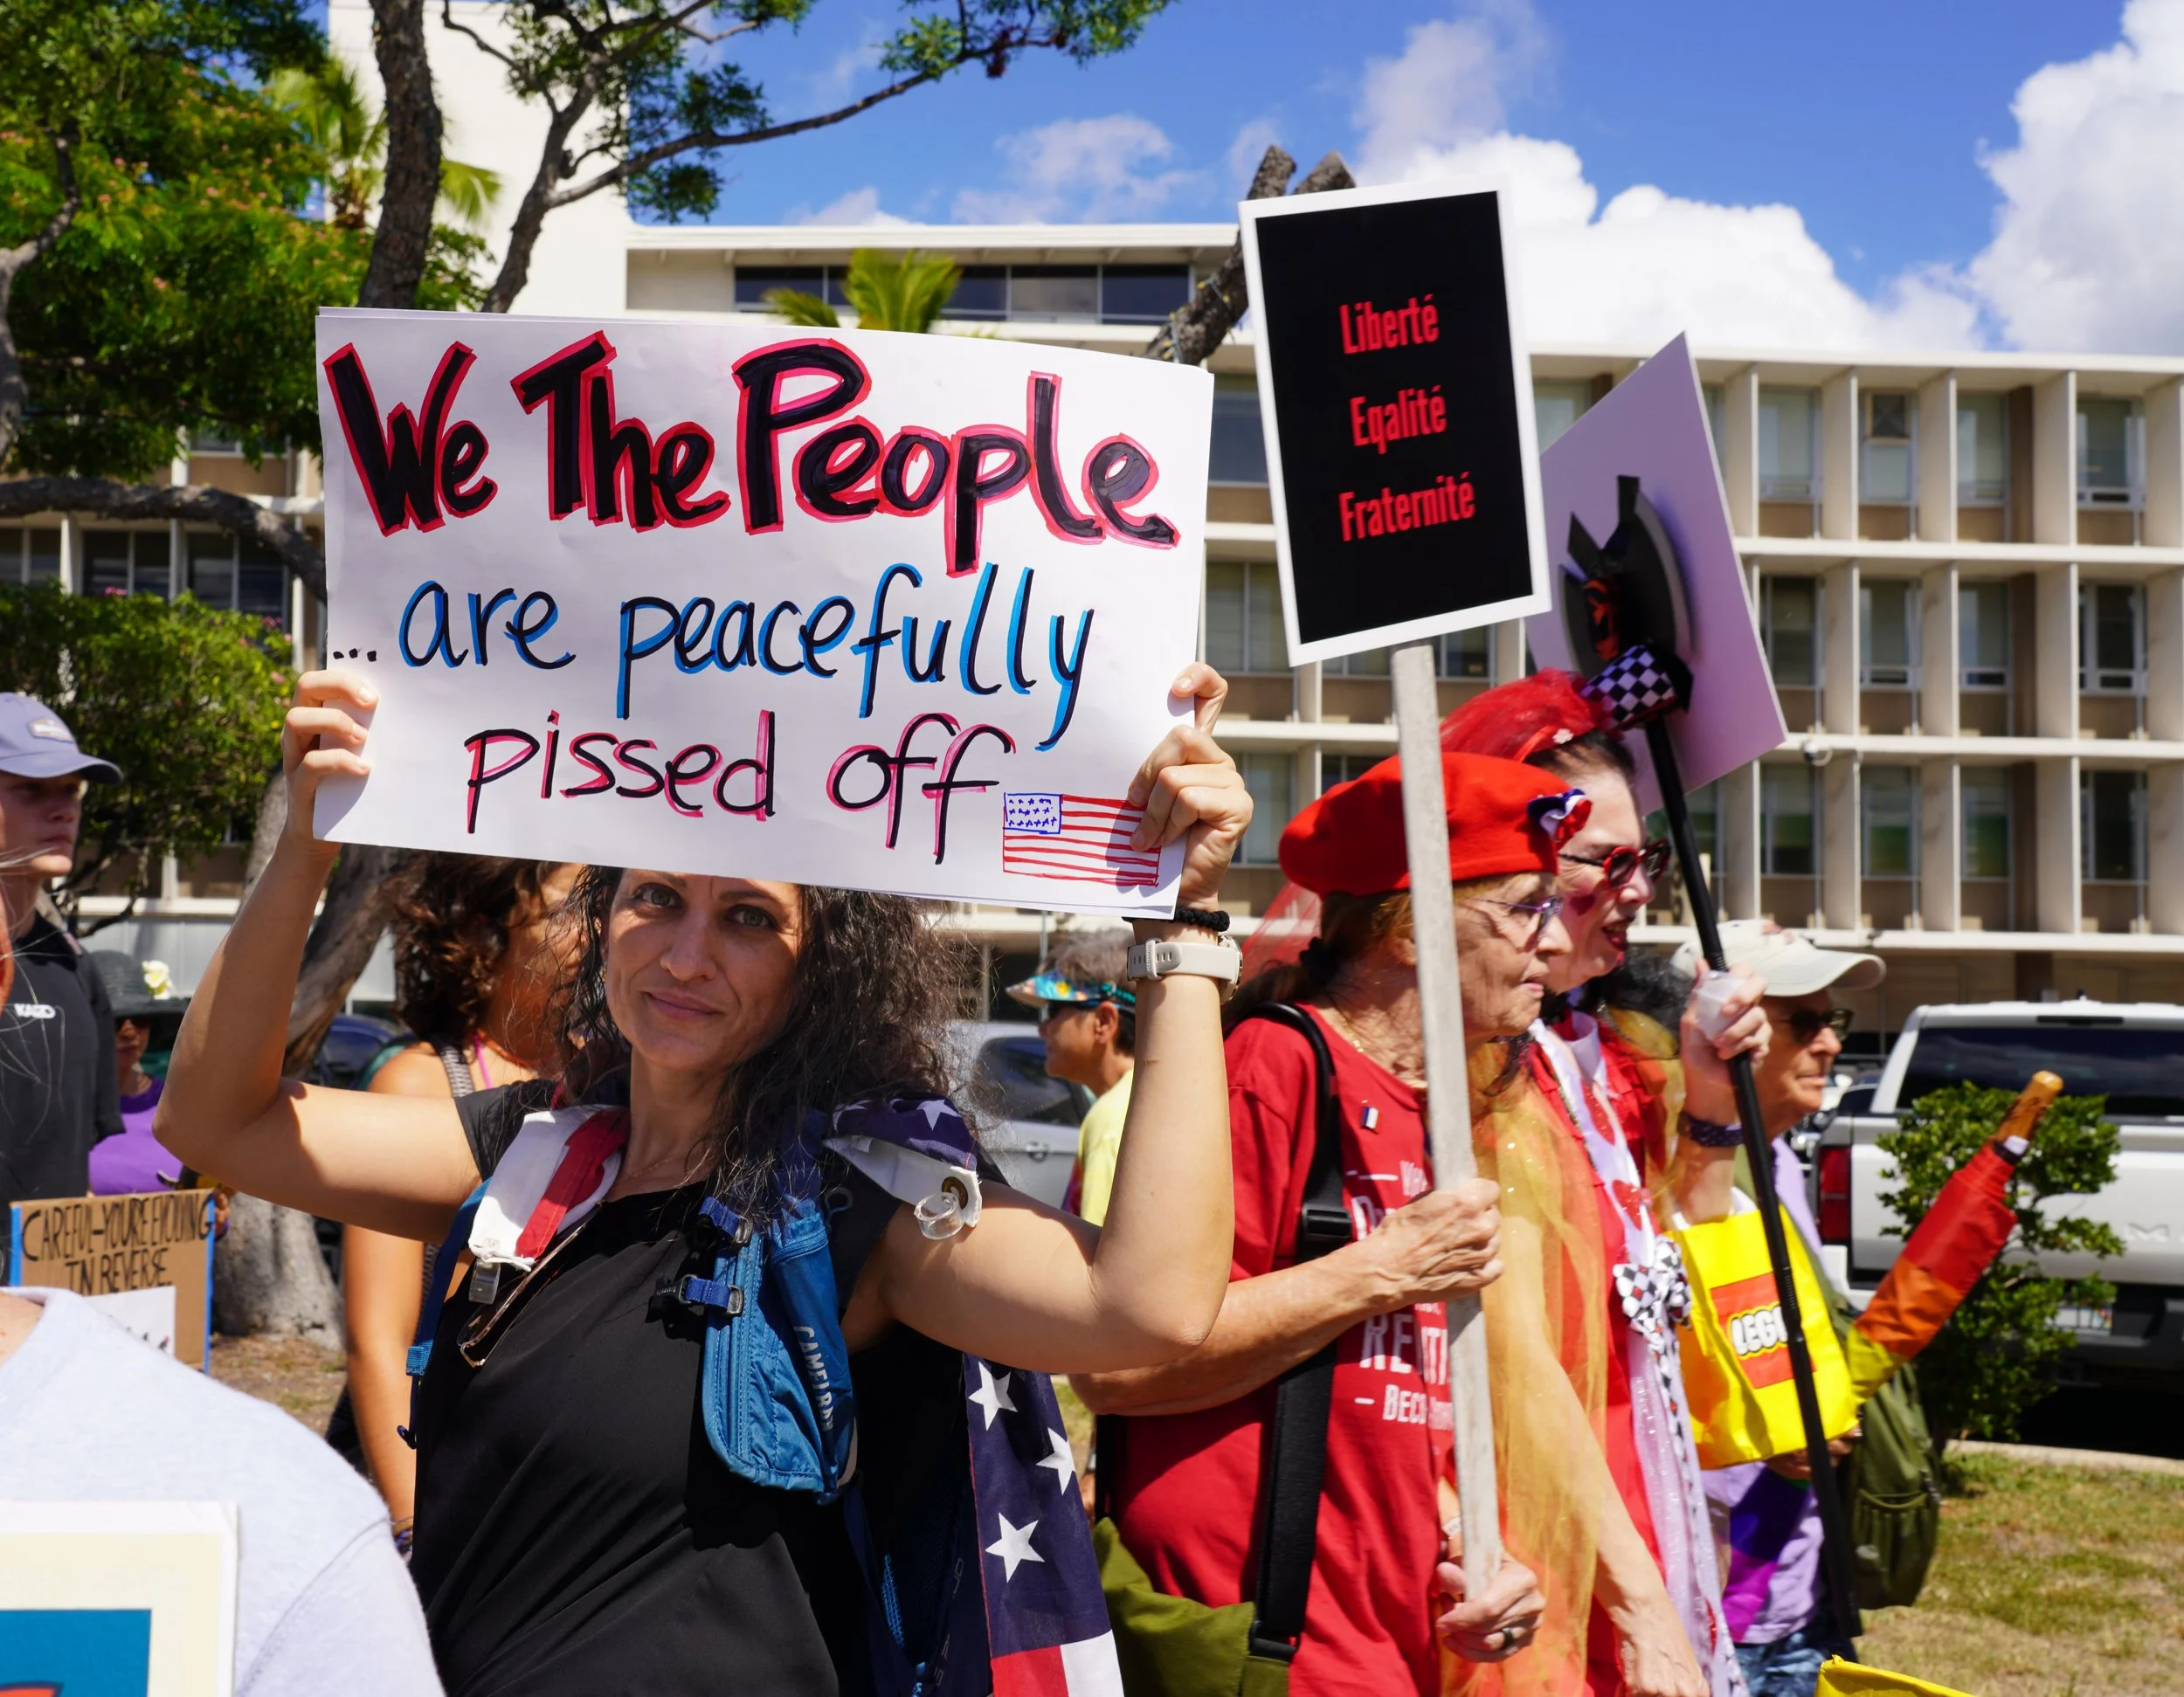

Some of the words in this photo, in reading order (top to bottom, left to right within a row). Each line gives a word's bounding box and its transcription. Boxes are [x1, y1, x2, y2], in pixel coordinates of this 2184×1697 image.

[1339, 293, 1440, 355] Liberté
[322, 341, 498, 536] We
[509, 330, 730, 533] The
[731, 338, 1181, 577] People
[1338, 471, 1476, 542] Fraternité
[616, 562, 1094, 752] peacefully
[465, 709, 775, 833] pissed
[826, 713, 1016, 865] off
[66, 1257, 95, 1296] IN
